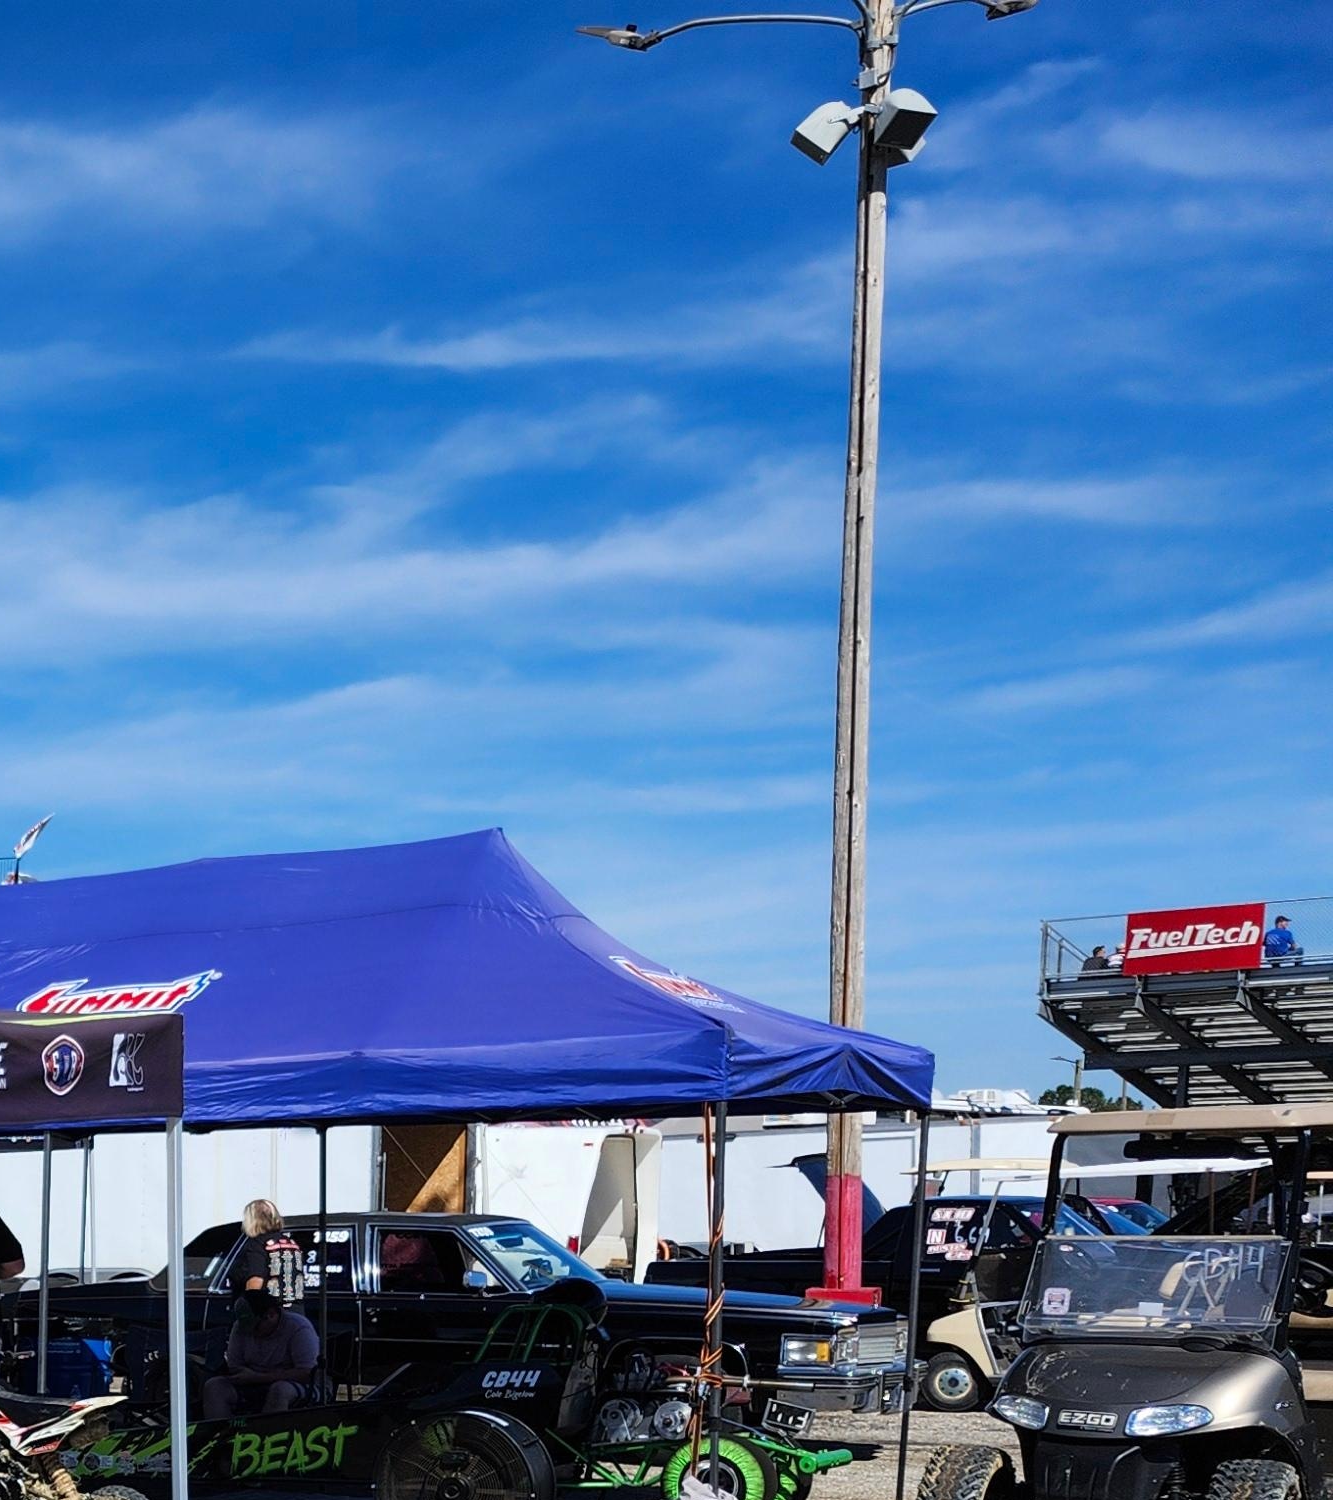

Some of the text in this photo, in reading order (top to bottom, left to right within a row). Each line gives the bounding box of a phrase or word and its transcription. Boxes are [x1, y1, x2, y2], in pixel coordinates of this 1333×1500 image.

[1130, 921, 1260, 950] FuelTech
[482, 1369, 541, 1389] CB44
[230, 1423, 359, 1480] BEAST
